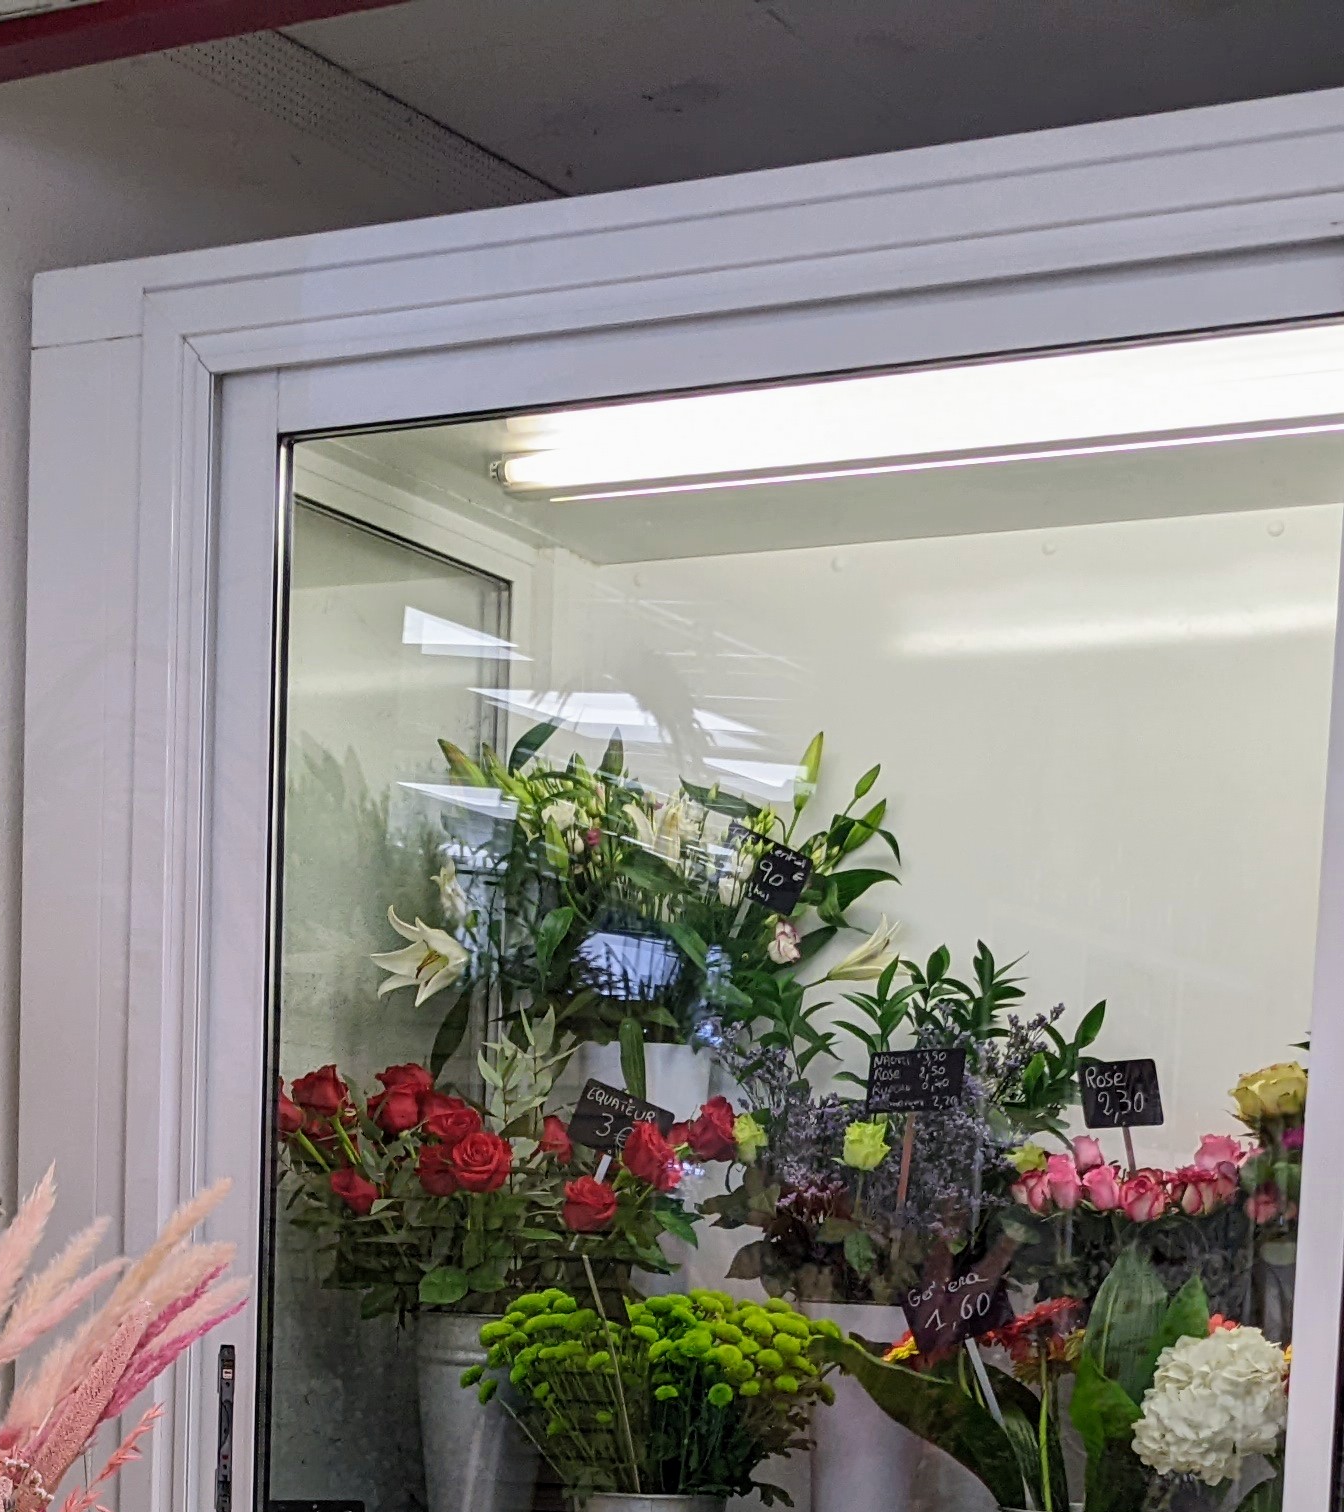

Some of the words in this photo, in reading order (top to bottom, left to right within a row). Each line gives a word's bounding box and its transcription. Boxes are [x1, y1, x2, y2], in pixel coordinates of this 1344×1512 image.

[1085, 1066, 1126, 1089] Rose
[1097, 1089, 1145, 1124] 2,30
[907, 1272, 989, 1307] Gerera
[924, 1292, 990, 1332] 1,60
